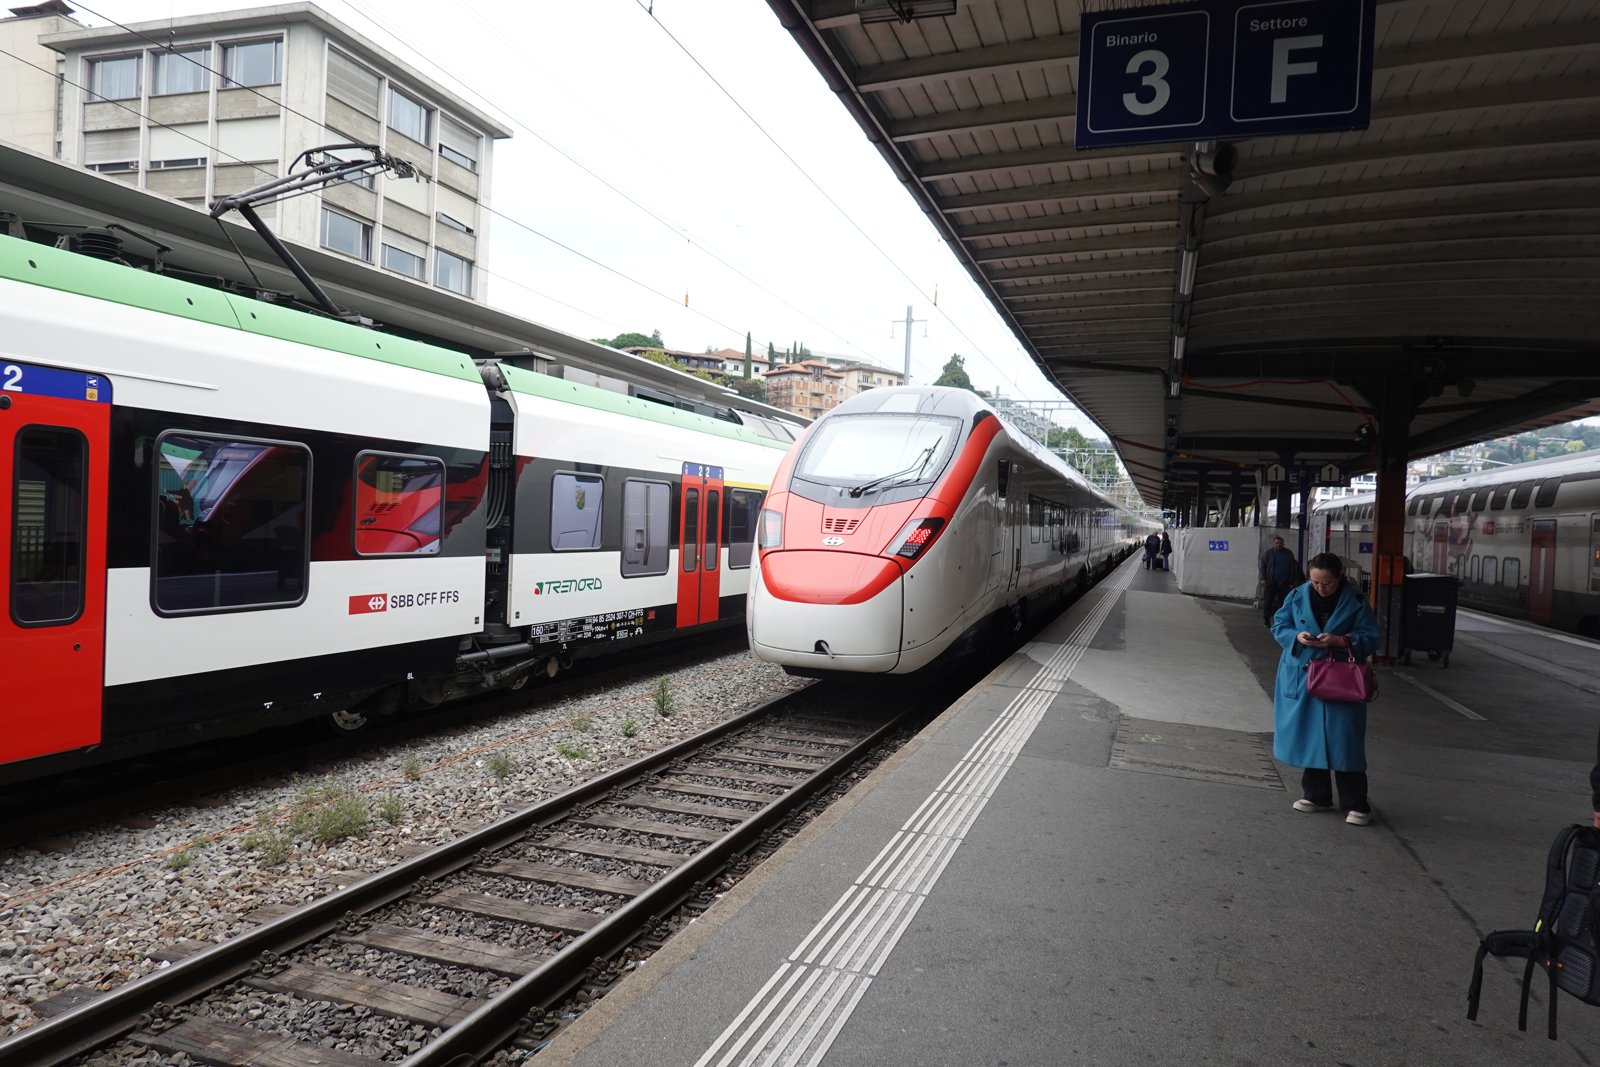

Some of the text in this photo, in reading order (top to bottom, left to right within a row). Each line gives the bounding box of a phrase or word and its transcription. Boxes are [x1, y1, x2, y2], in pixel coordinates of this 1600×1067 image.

[1249, 16, 1308, 32] Settore
[1106, 31, 1158, 47] Binario
[1270, 34, 1324, 104] F
[1122, 49, 1171, 116] 3
[2, 364, 23, 392] 2
[698, 465, 703, 477] 2
[705, 466, 710, 478] 2
[1273, 467, 1279, 480] 1
[1327, 467, 1333, 480] 1
[545, 577, 603, 595] TRENORD
[390, 590, 460, 609] SBB CFF FFS
[532, 625, 544, 636] 160
